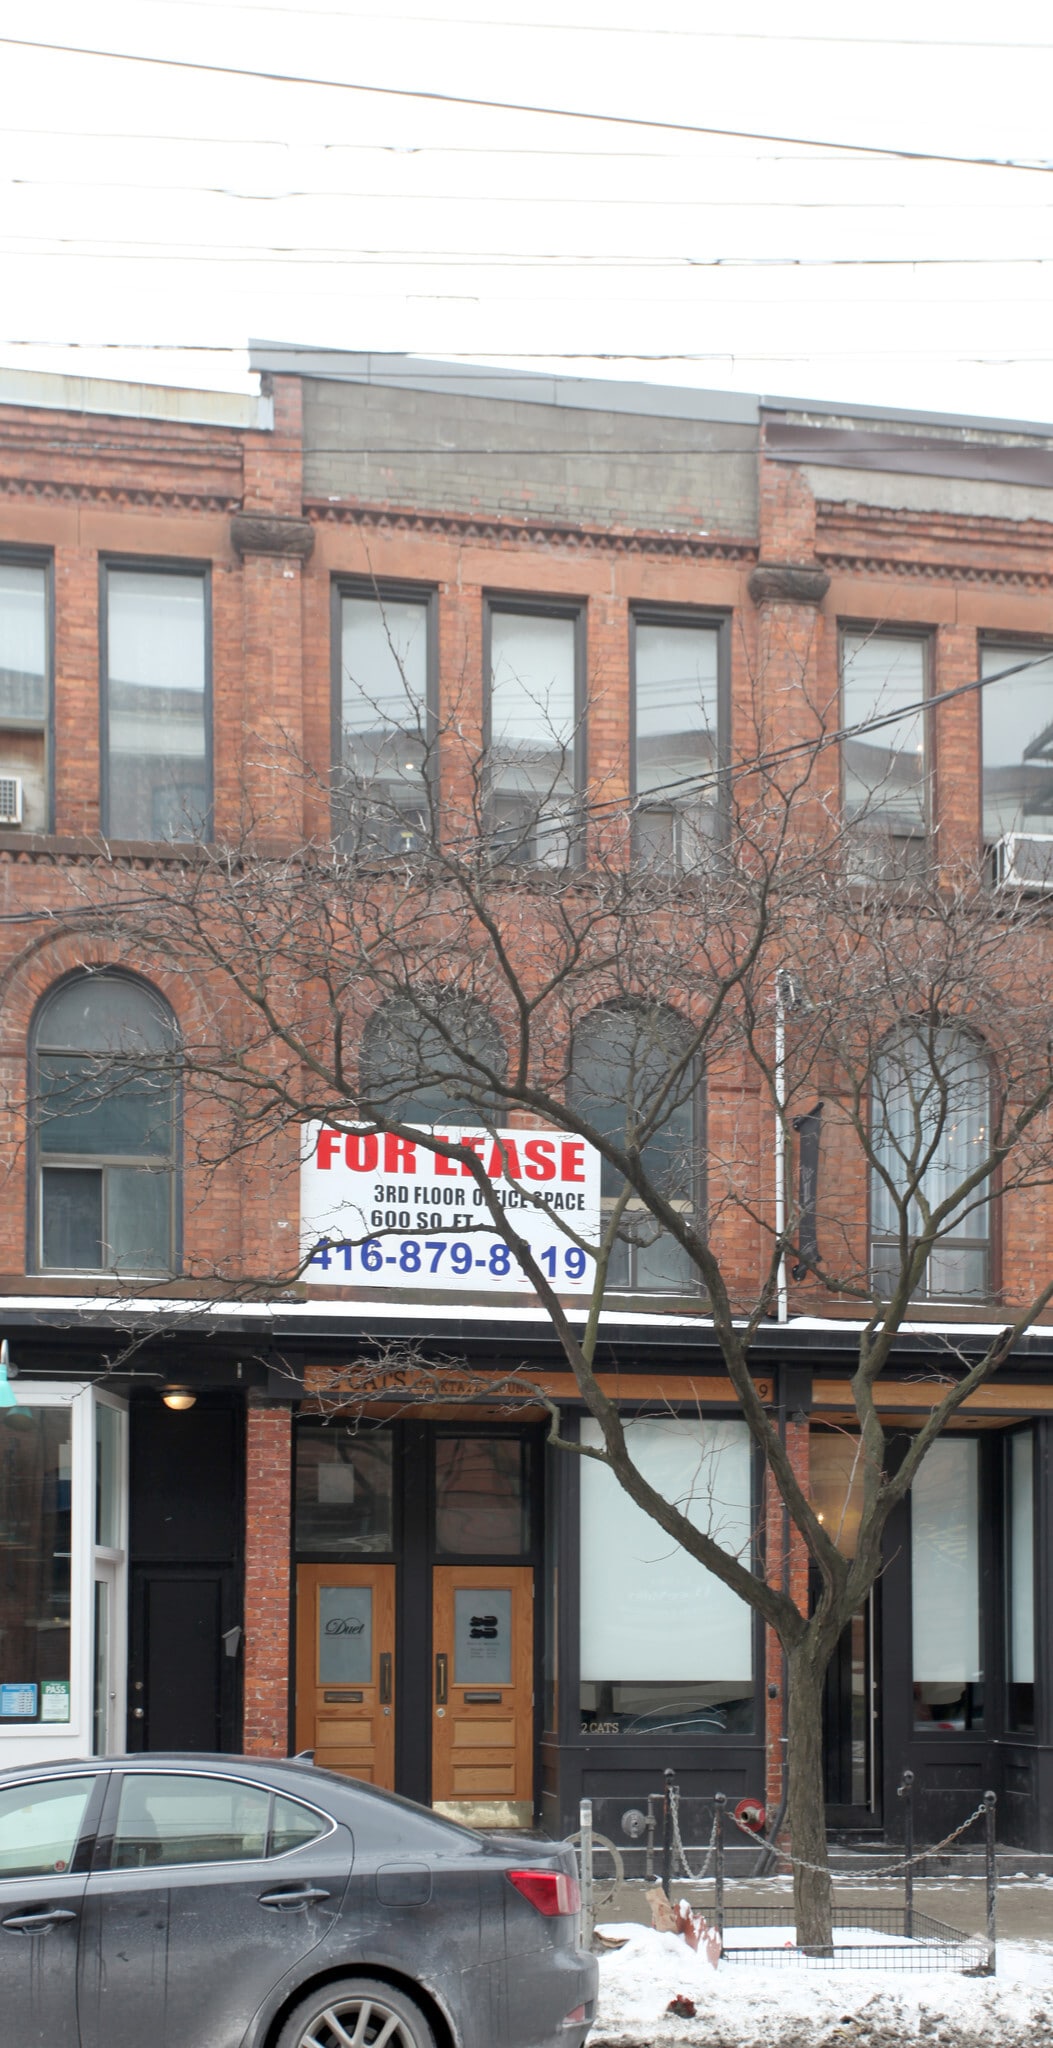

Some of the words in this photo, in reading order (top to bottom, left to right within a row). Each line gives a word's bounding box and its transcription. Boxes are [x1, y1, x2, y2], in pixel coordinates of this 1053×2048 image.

[316, 1129, 417, 1174] FOR
[434, 1136, 586, 1182] LEASE
[374, 1184, 408, 1204] 3RD
[414, 1186, 465, 1206] FLOOR
[371, 1210, 411, 1228] 600
[309, 1237, 587, 1279] 416-879-819
[324, 1617, 365, 1635] Duet
[45, 1685, 66, 1694] PASS
[581, 1722, 588, 1734] 2
[589, 1722, 619, 1734] CATS
